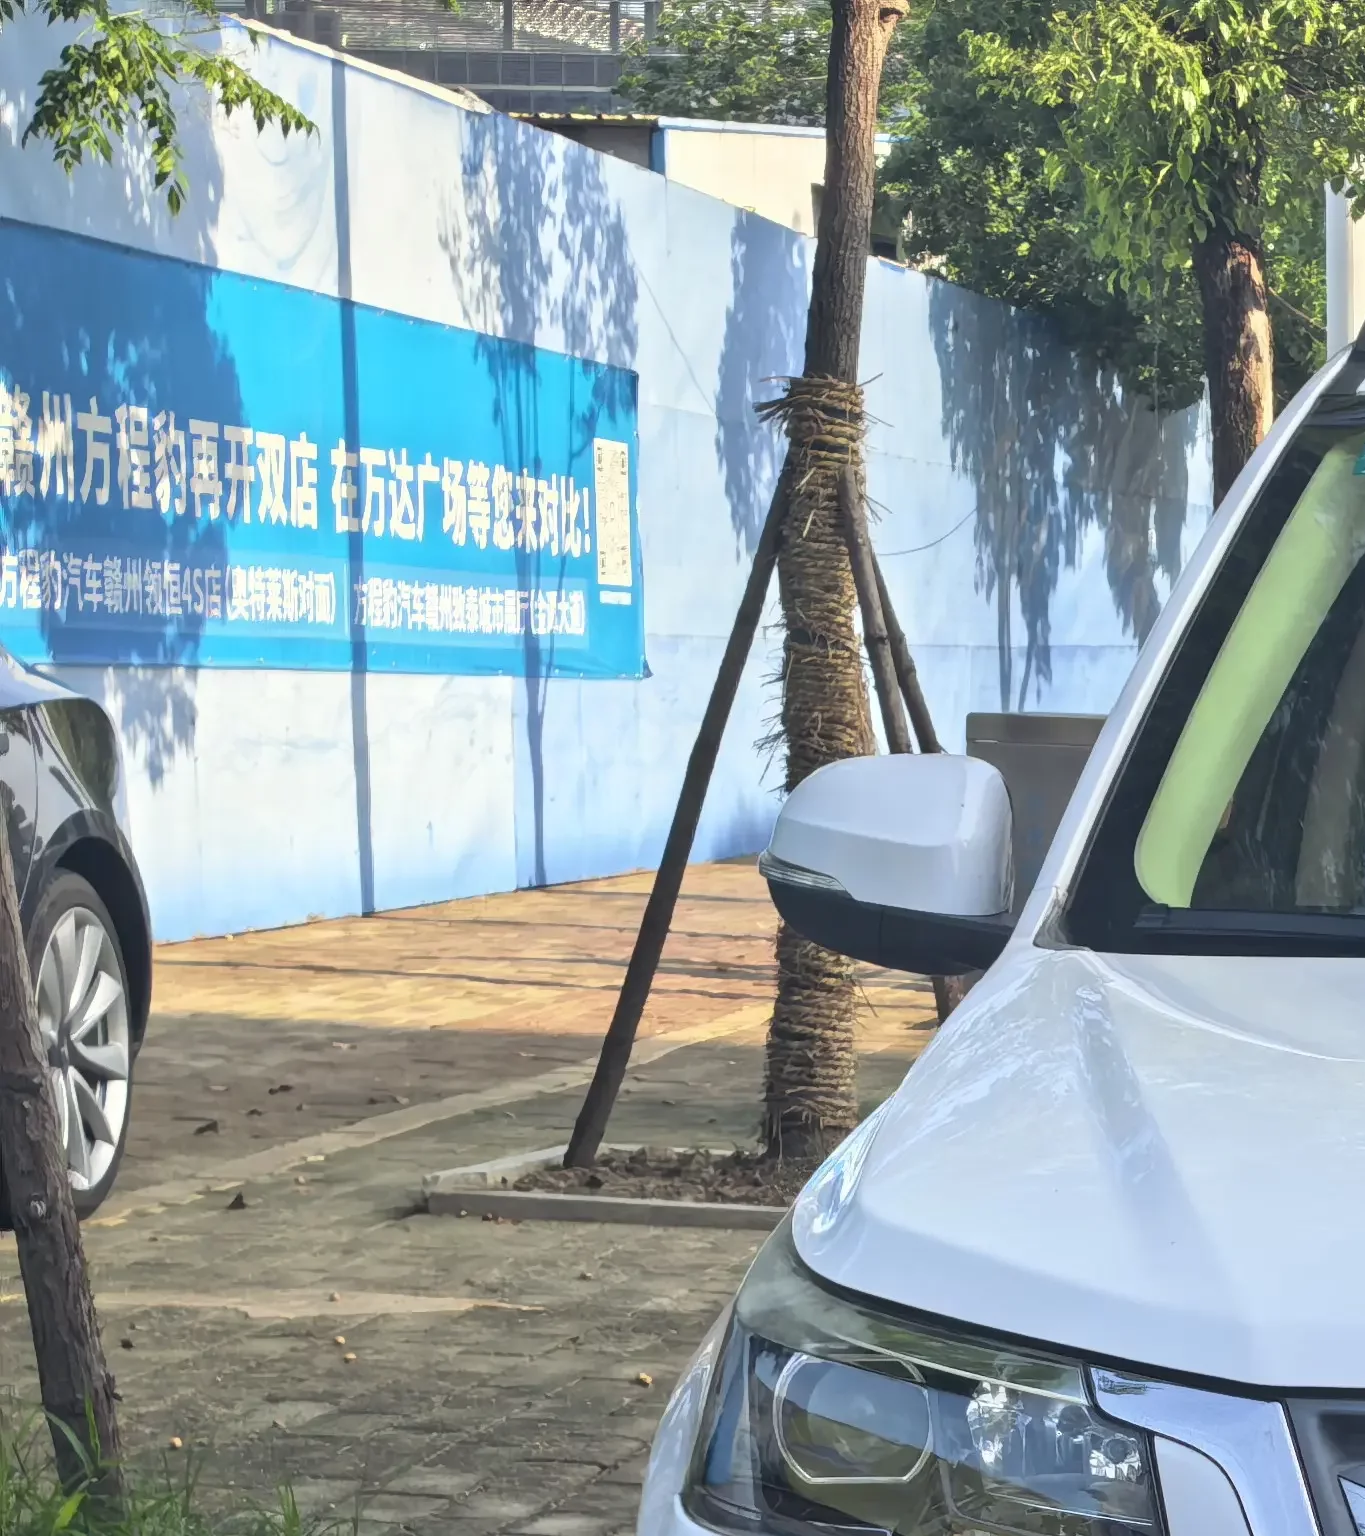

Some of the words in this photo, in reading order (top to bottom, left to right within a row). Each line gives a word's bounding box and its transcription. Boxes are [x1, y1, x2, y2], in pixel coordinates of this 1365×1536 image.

[0, 383, 318, 529] 赣州方程豹再开双店
